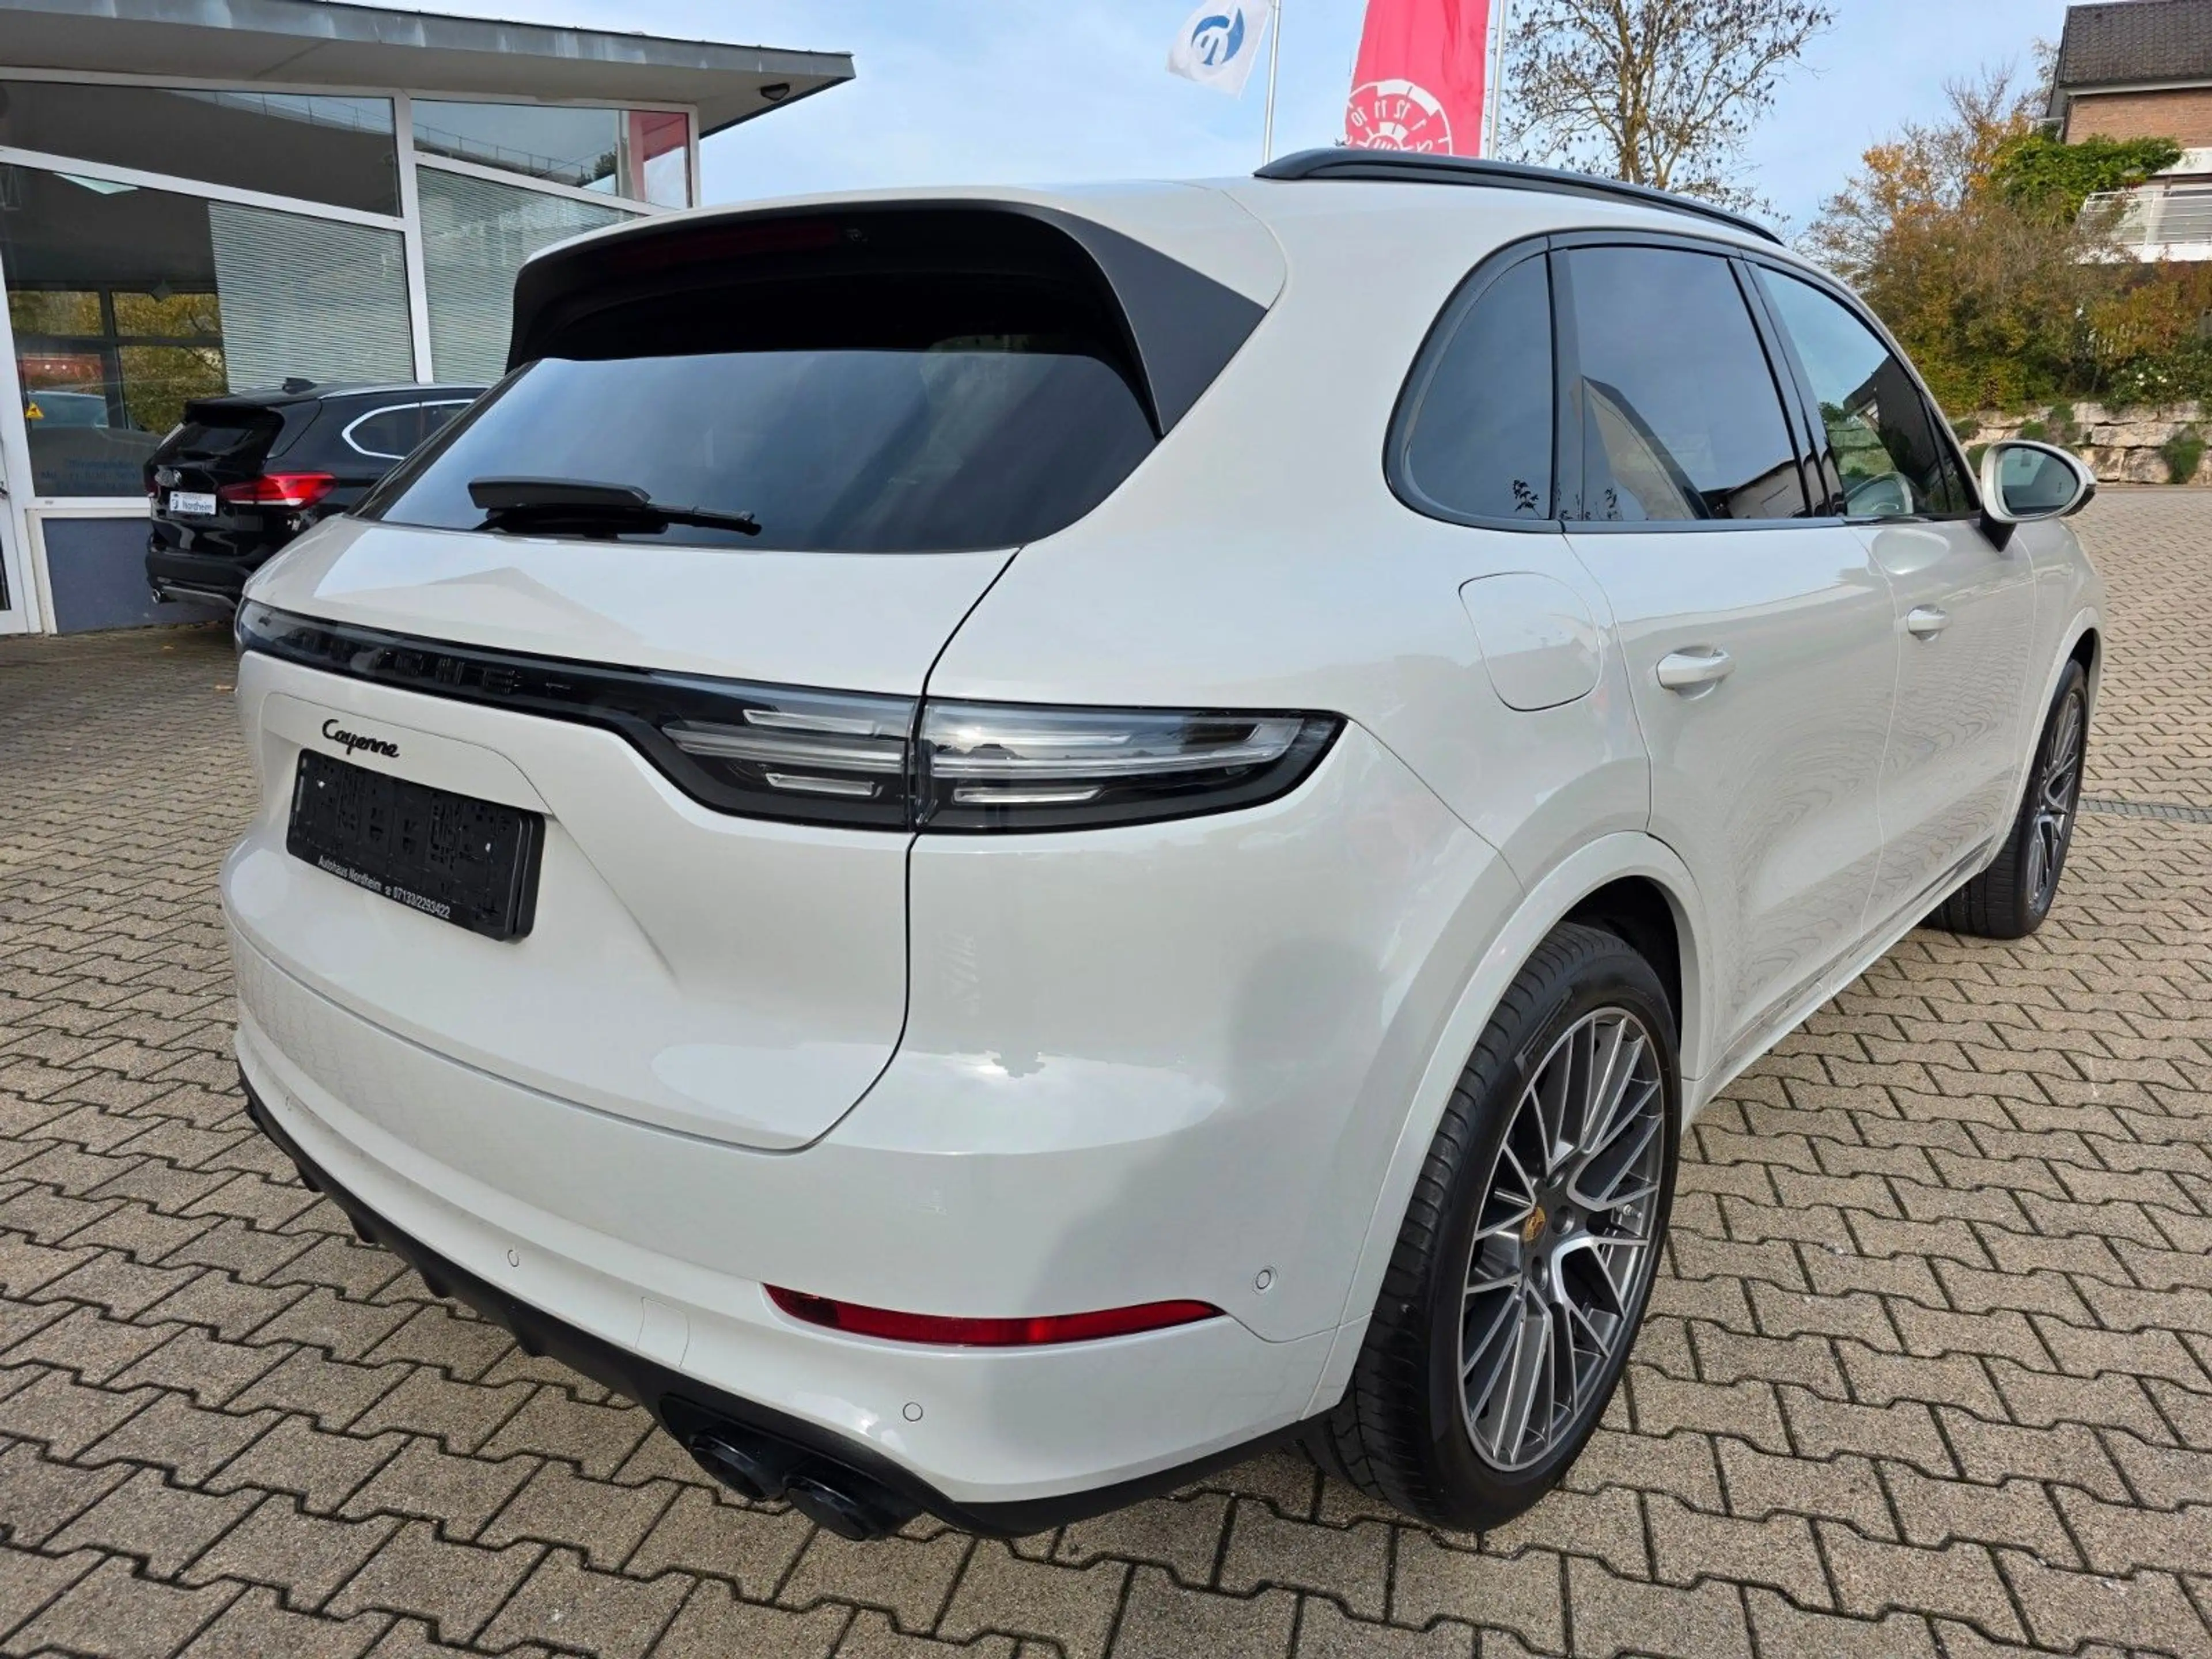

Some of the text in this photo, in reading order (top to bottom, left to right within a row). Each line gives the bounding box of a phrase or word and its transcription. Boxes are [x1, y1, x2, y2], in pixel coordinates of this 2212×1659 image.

[322, 719, 400, 757] Cayenne
[318, 855, 347, 877] Autohaus
[349, 866, 382, 891] Nordheim
